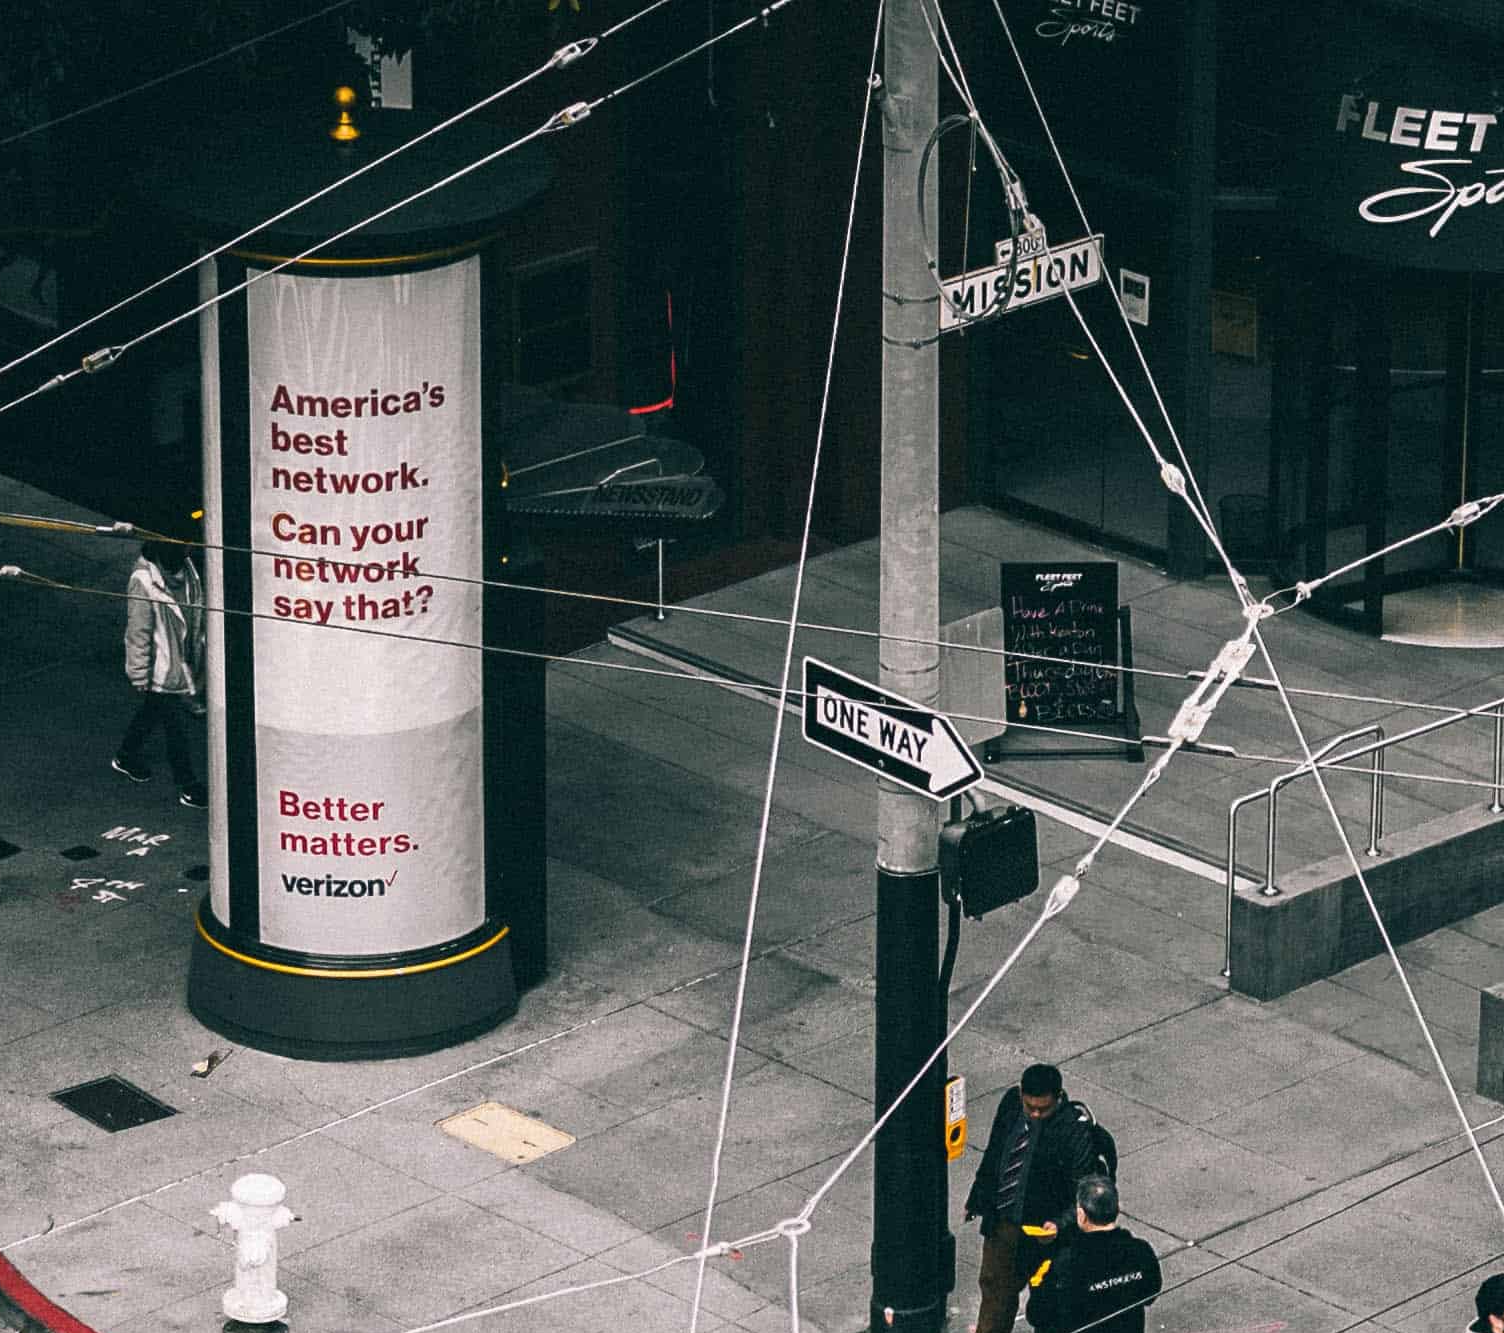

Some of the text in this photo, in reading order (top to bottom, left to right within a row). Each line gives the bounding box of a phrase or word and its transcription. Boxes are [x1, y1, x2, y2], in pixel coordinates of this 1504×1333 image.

[1336, 94, 1498, 152] FLEET
[952, 250, 1089, 319] MISSION
[270, 381, 445, 418] America's
[270, 424, 348, 457] best
[271, 461, 429, 495] network.
[272, 513, 428, 556] Can your
[273, 552, 420, 586] network
[273, 584, 434, 625] say that?
[823, 694, 928, 763] ONE WAY
[279, 791, 385, 823] Better
[280, 826, 419, 857] matters.
[281, 872, 387, 899] verizon
